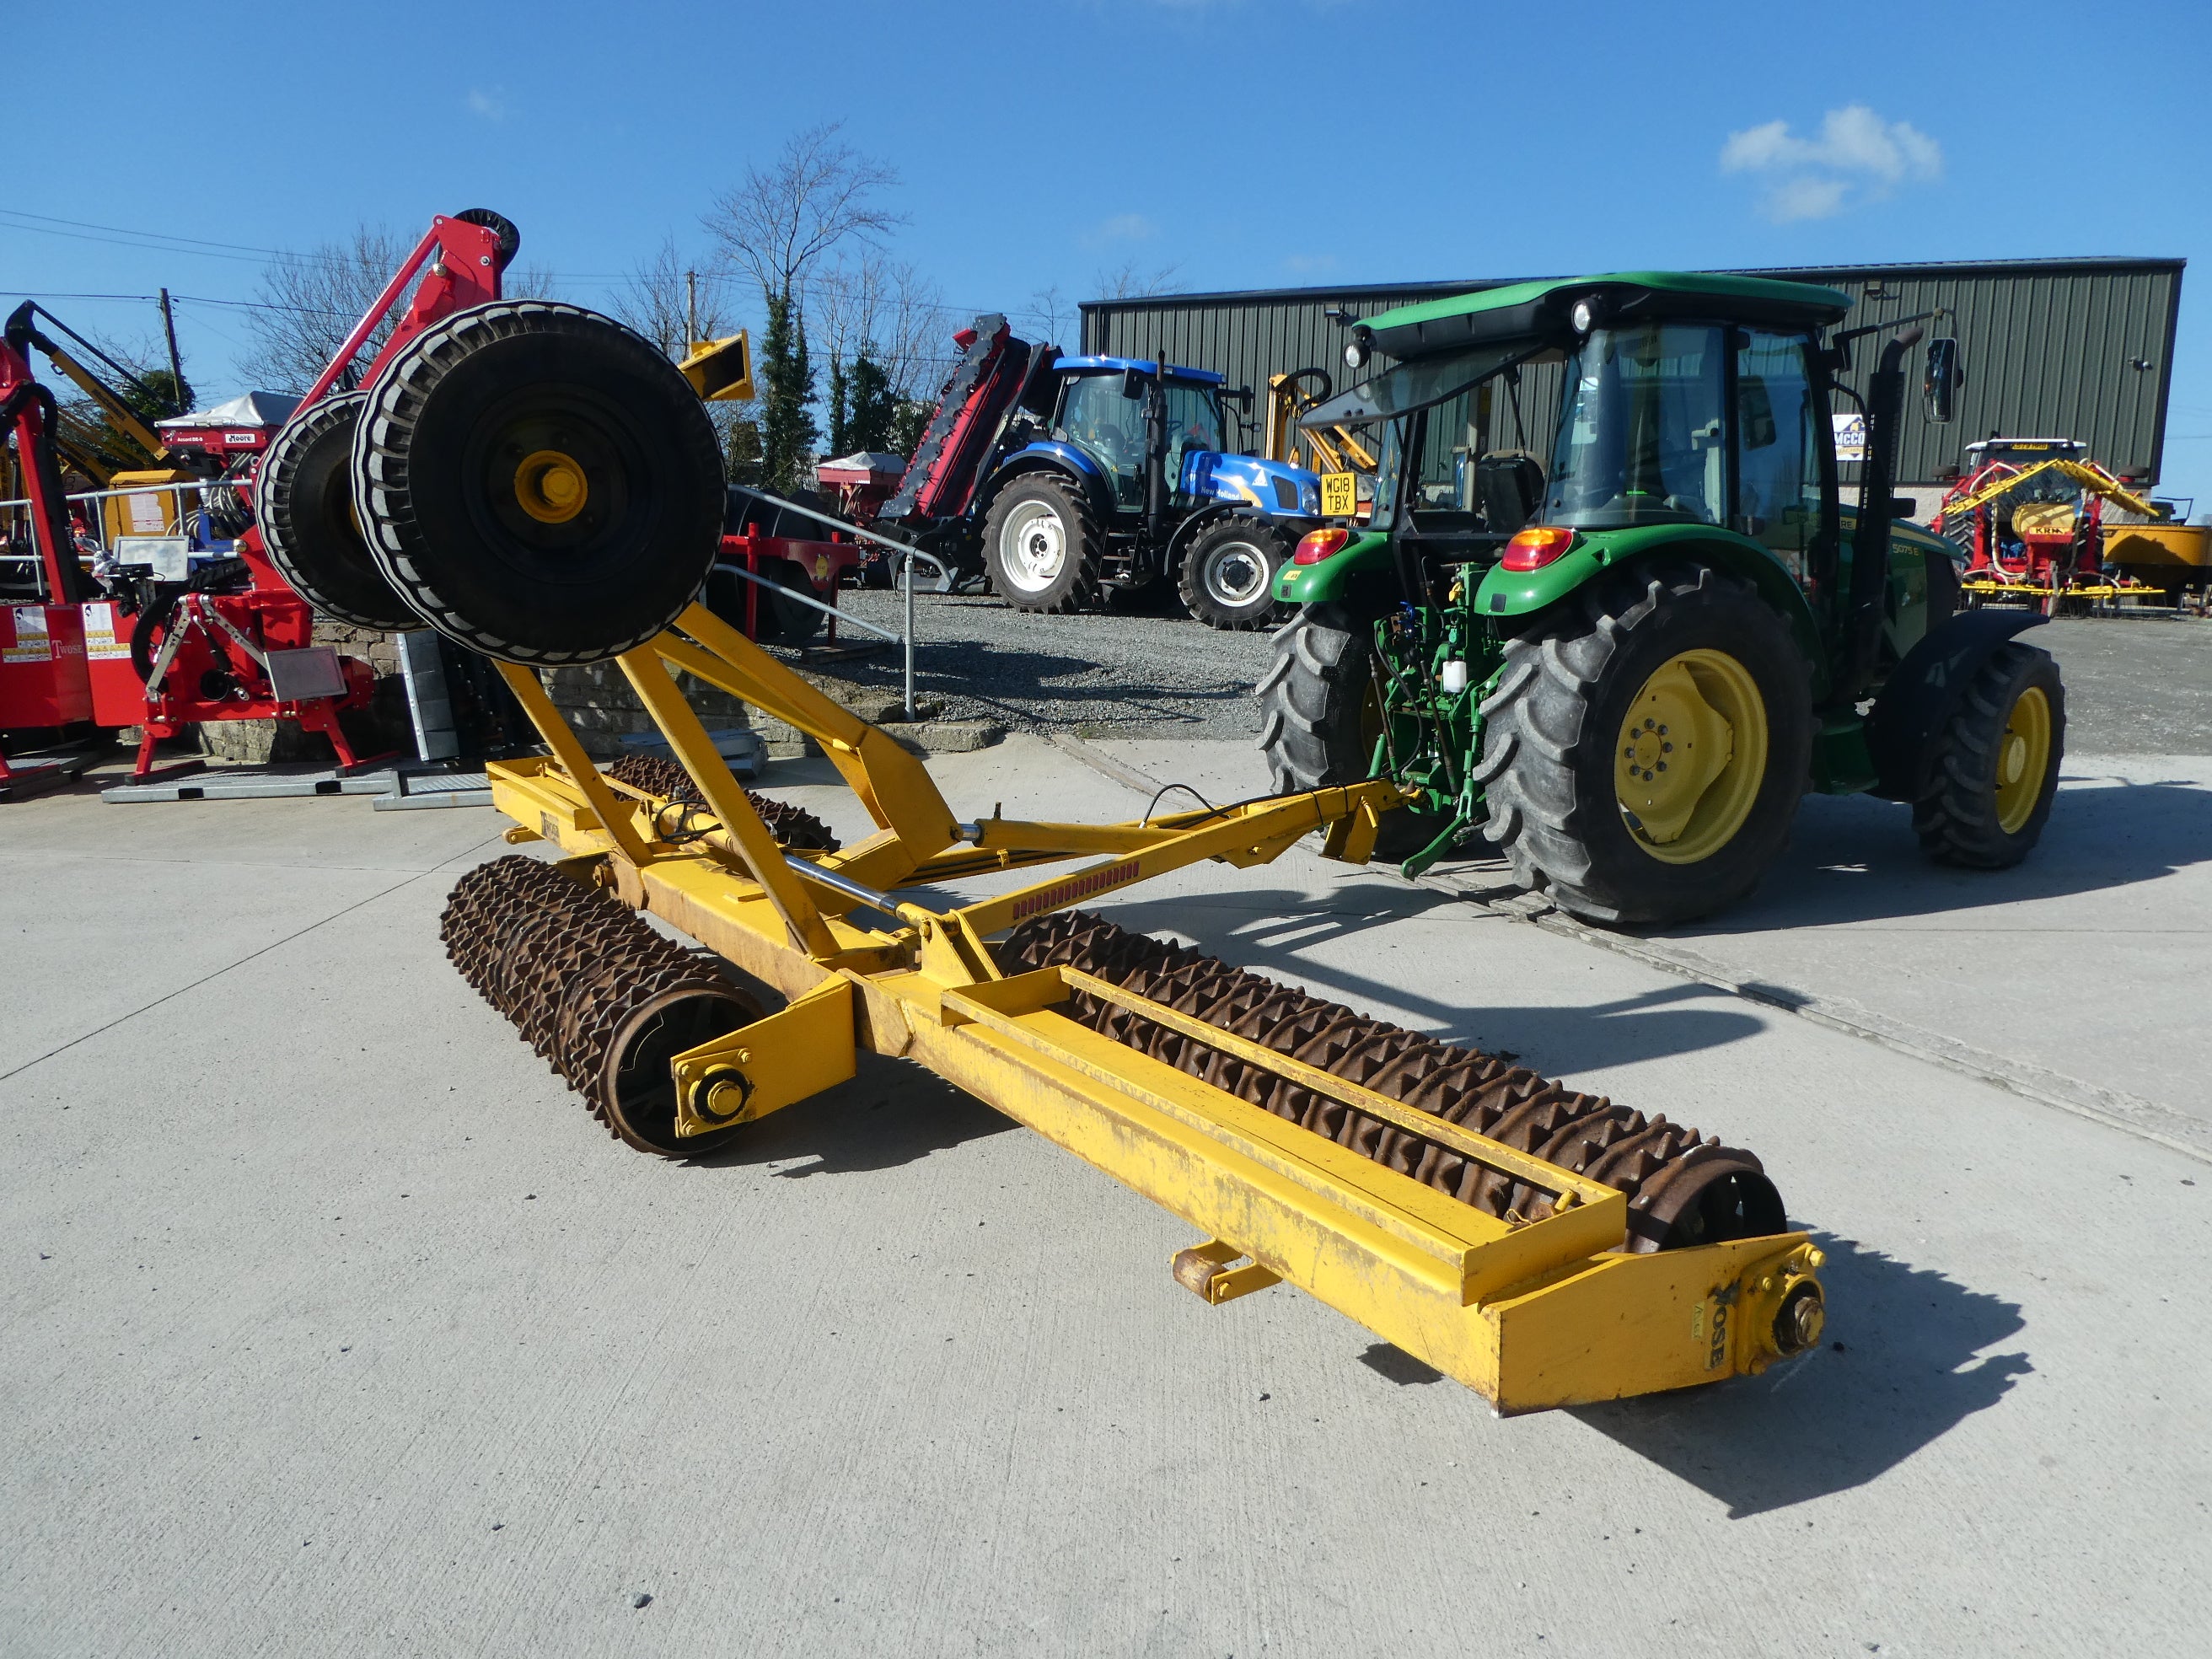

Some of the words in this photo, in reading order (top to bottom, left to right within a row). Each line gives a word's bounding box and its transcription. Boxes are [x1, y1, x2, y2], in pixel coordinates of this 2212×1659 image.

[228, 434, 251, 443] Moore
[1326, 477, 1350, 493] WG18
[1201, 486, 1214, 496] New
[1216, 489, 1239, 501] Holland
[1328, 495, 1349, 511] TBX
[51, 639, 83, 659] TWOSE
